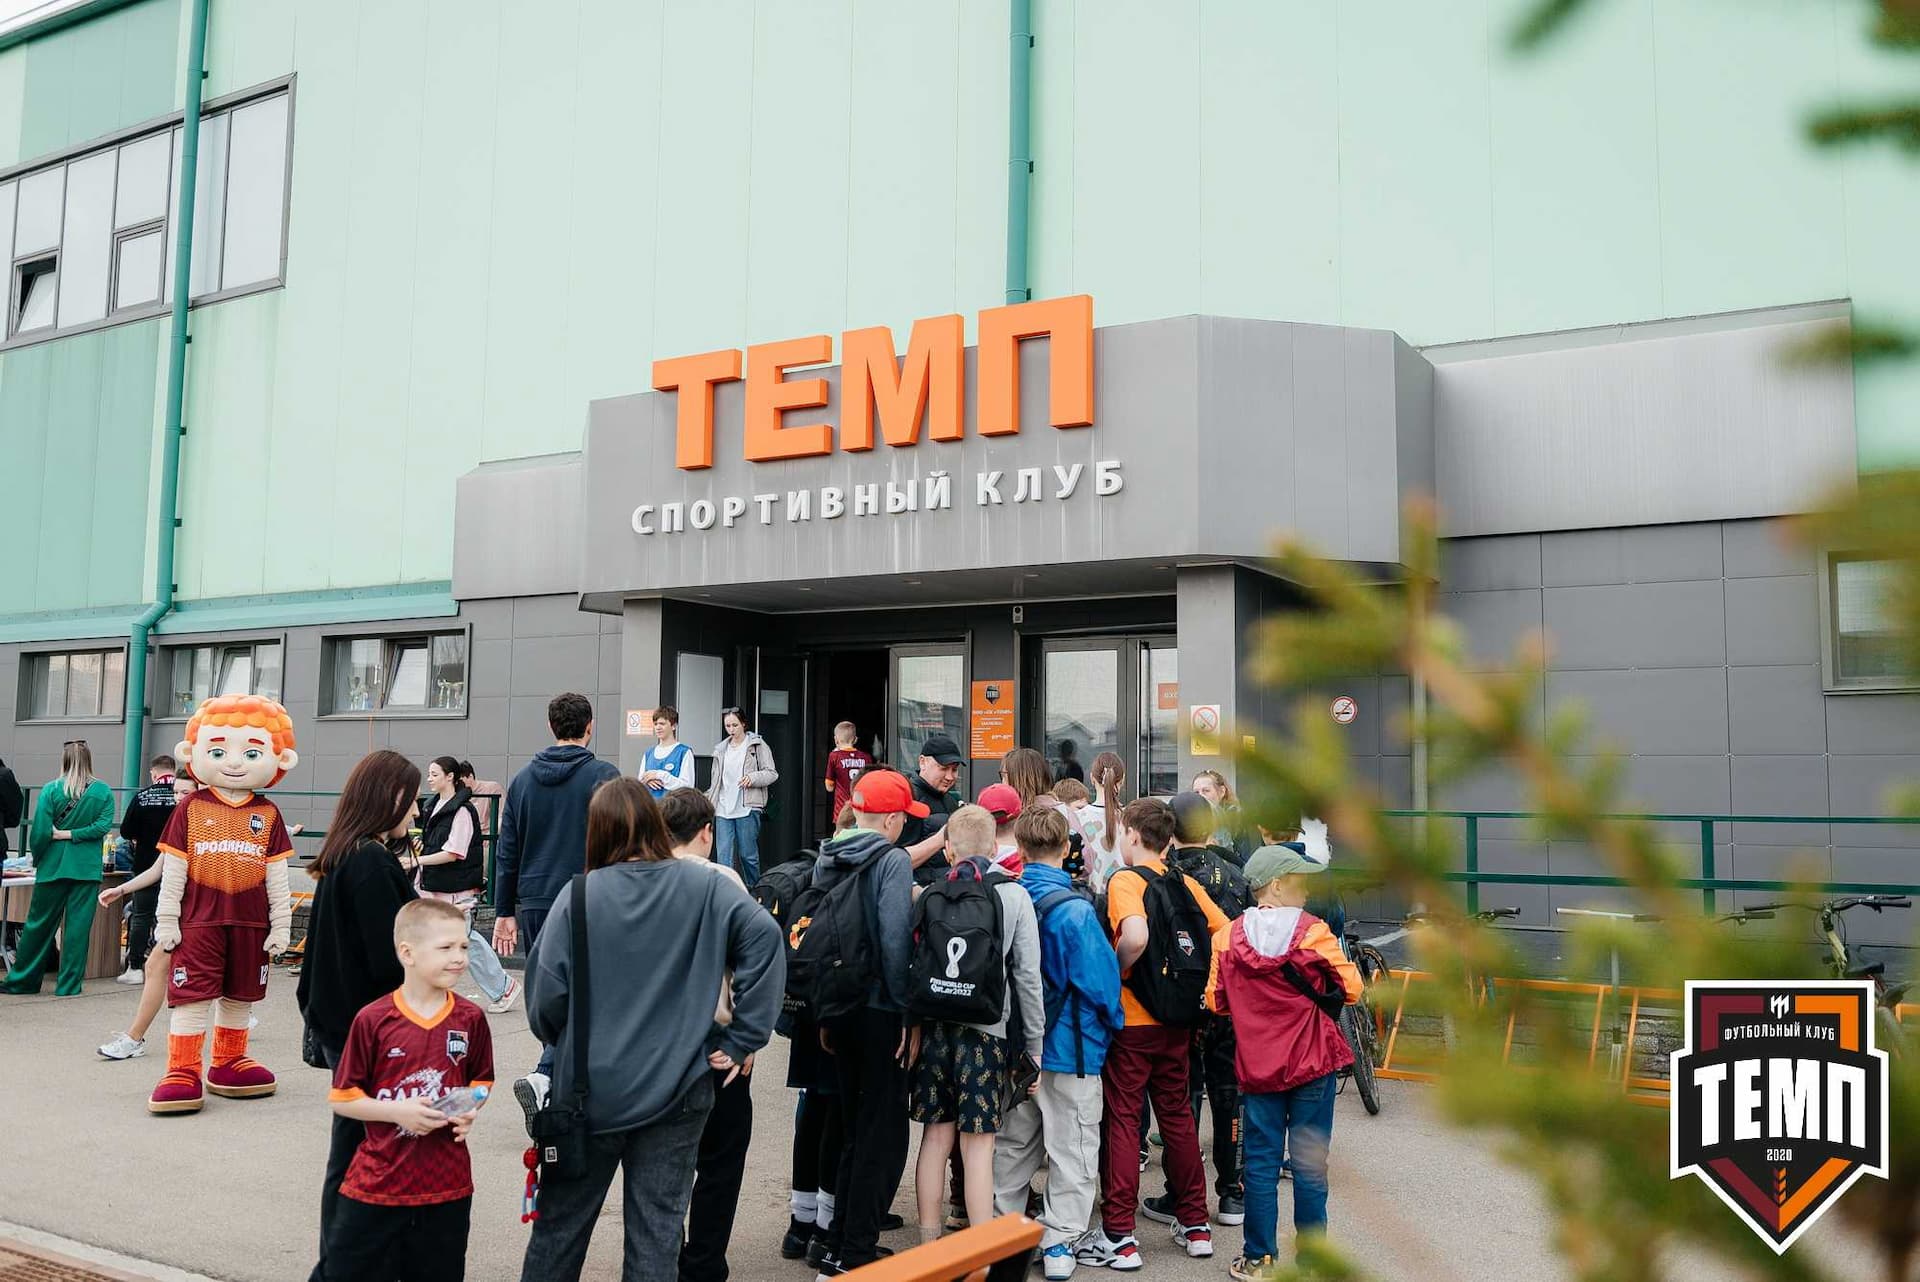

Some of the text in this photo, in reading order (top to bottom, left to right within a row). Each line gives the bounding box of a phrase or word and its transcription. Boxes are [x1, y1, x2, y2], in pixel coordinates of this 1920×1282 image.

[652, 294, 1094, 470] ТЕМП
[631, 460, 1124, 534] СПОРТИВНЫЙ КЛУБ
